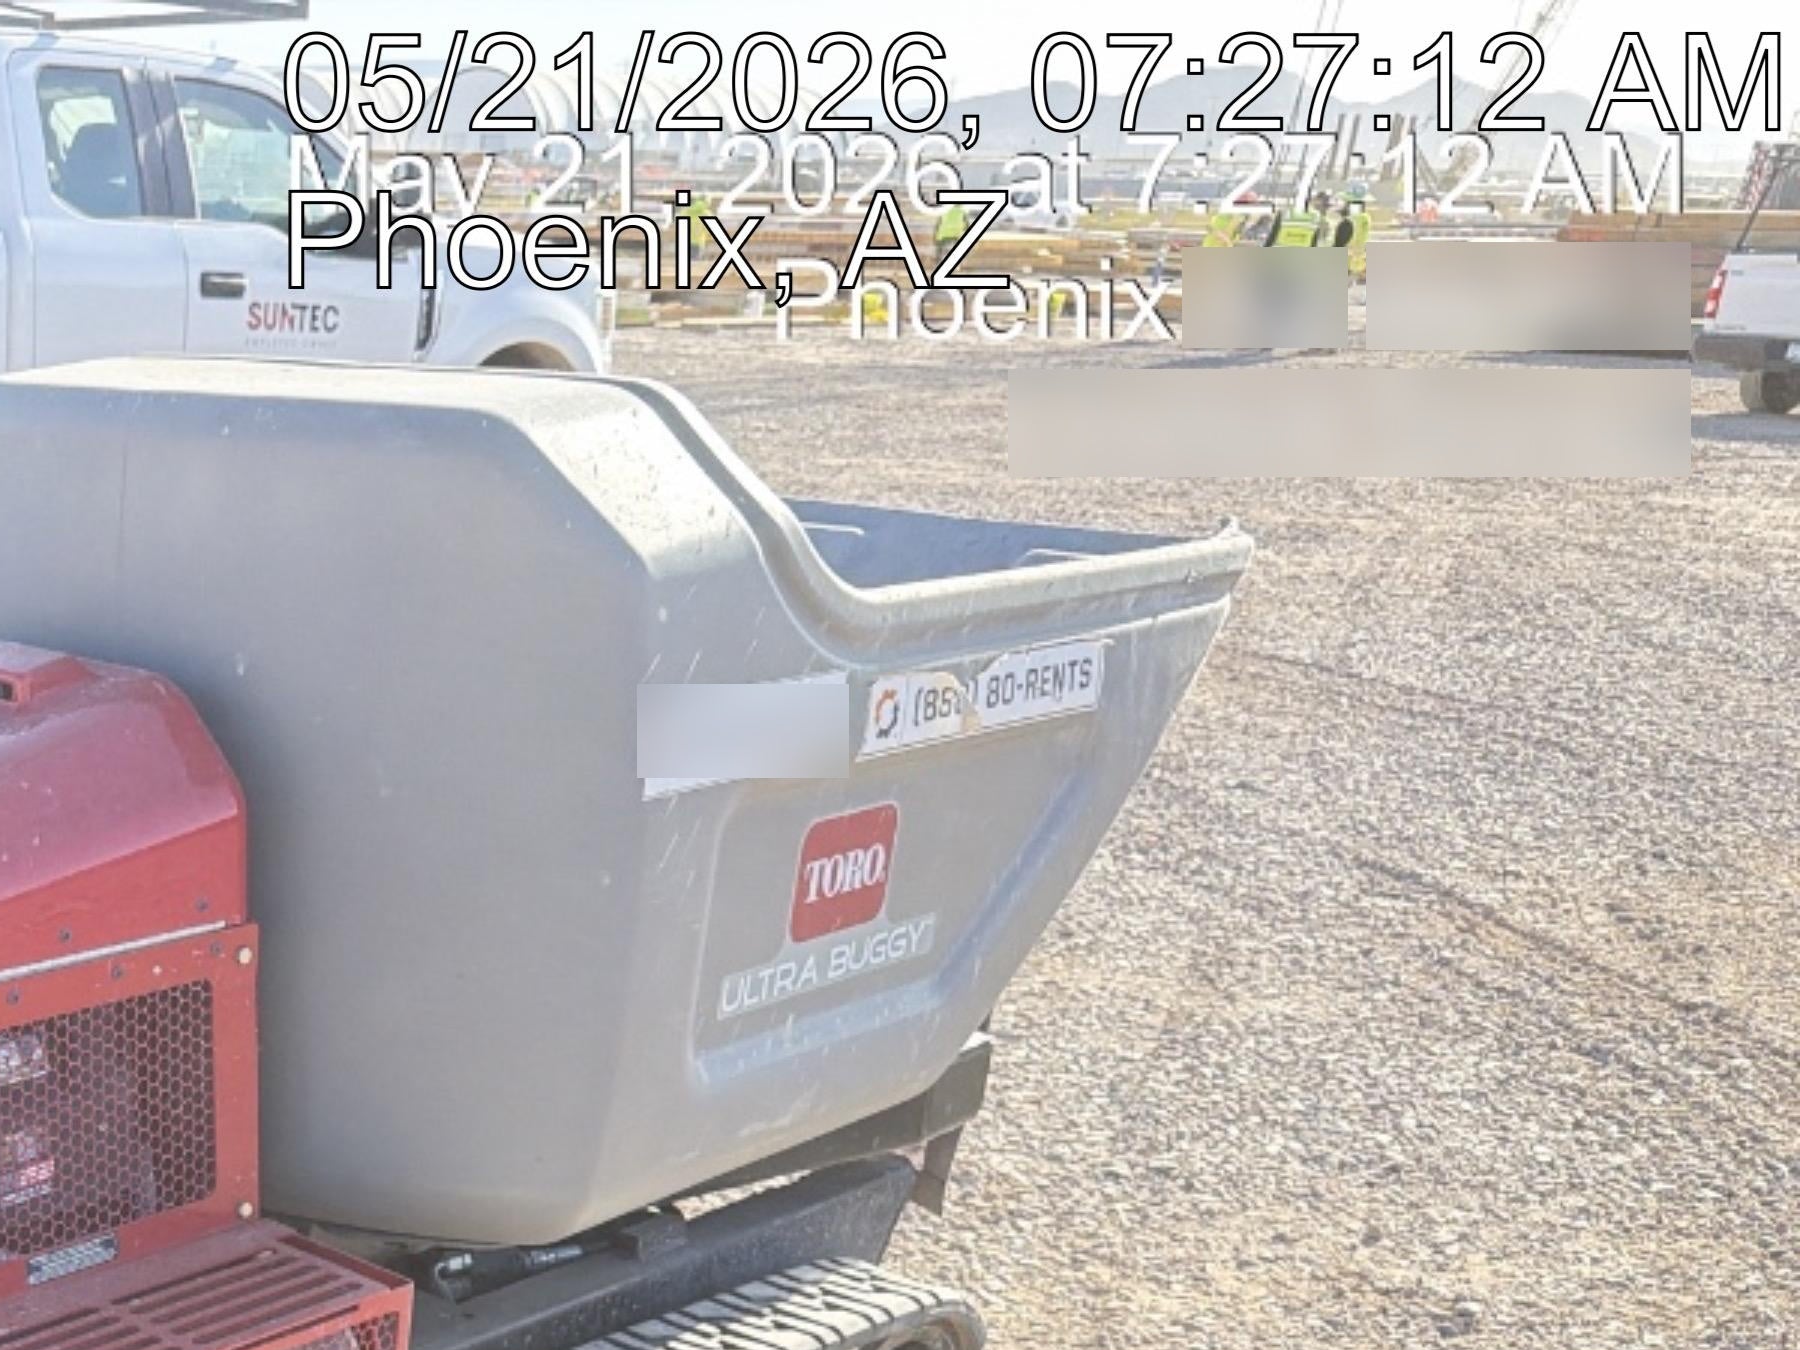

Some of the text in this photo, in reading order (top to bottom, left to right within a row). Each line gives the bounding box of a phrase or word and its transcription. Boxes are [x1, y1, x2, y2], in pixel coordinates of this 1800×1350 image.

[247, 301, 340, 334] SUNTEC
[986, 657, 1093, 709] 80-RENTS
[804, 843, 885, 904] TORO
[720, 918, 928, 1013] ULTRA BUGGY
